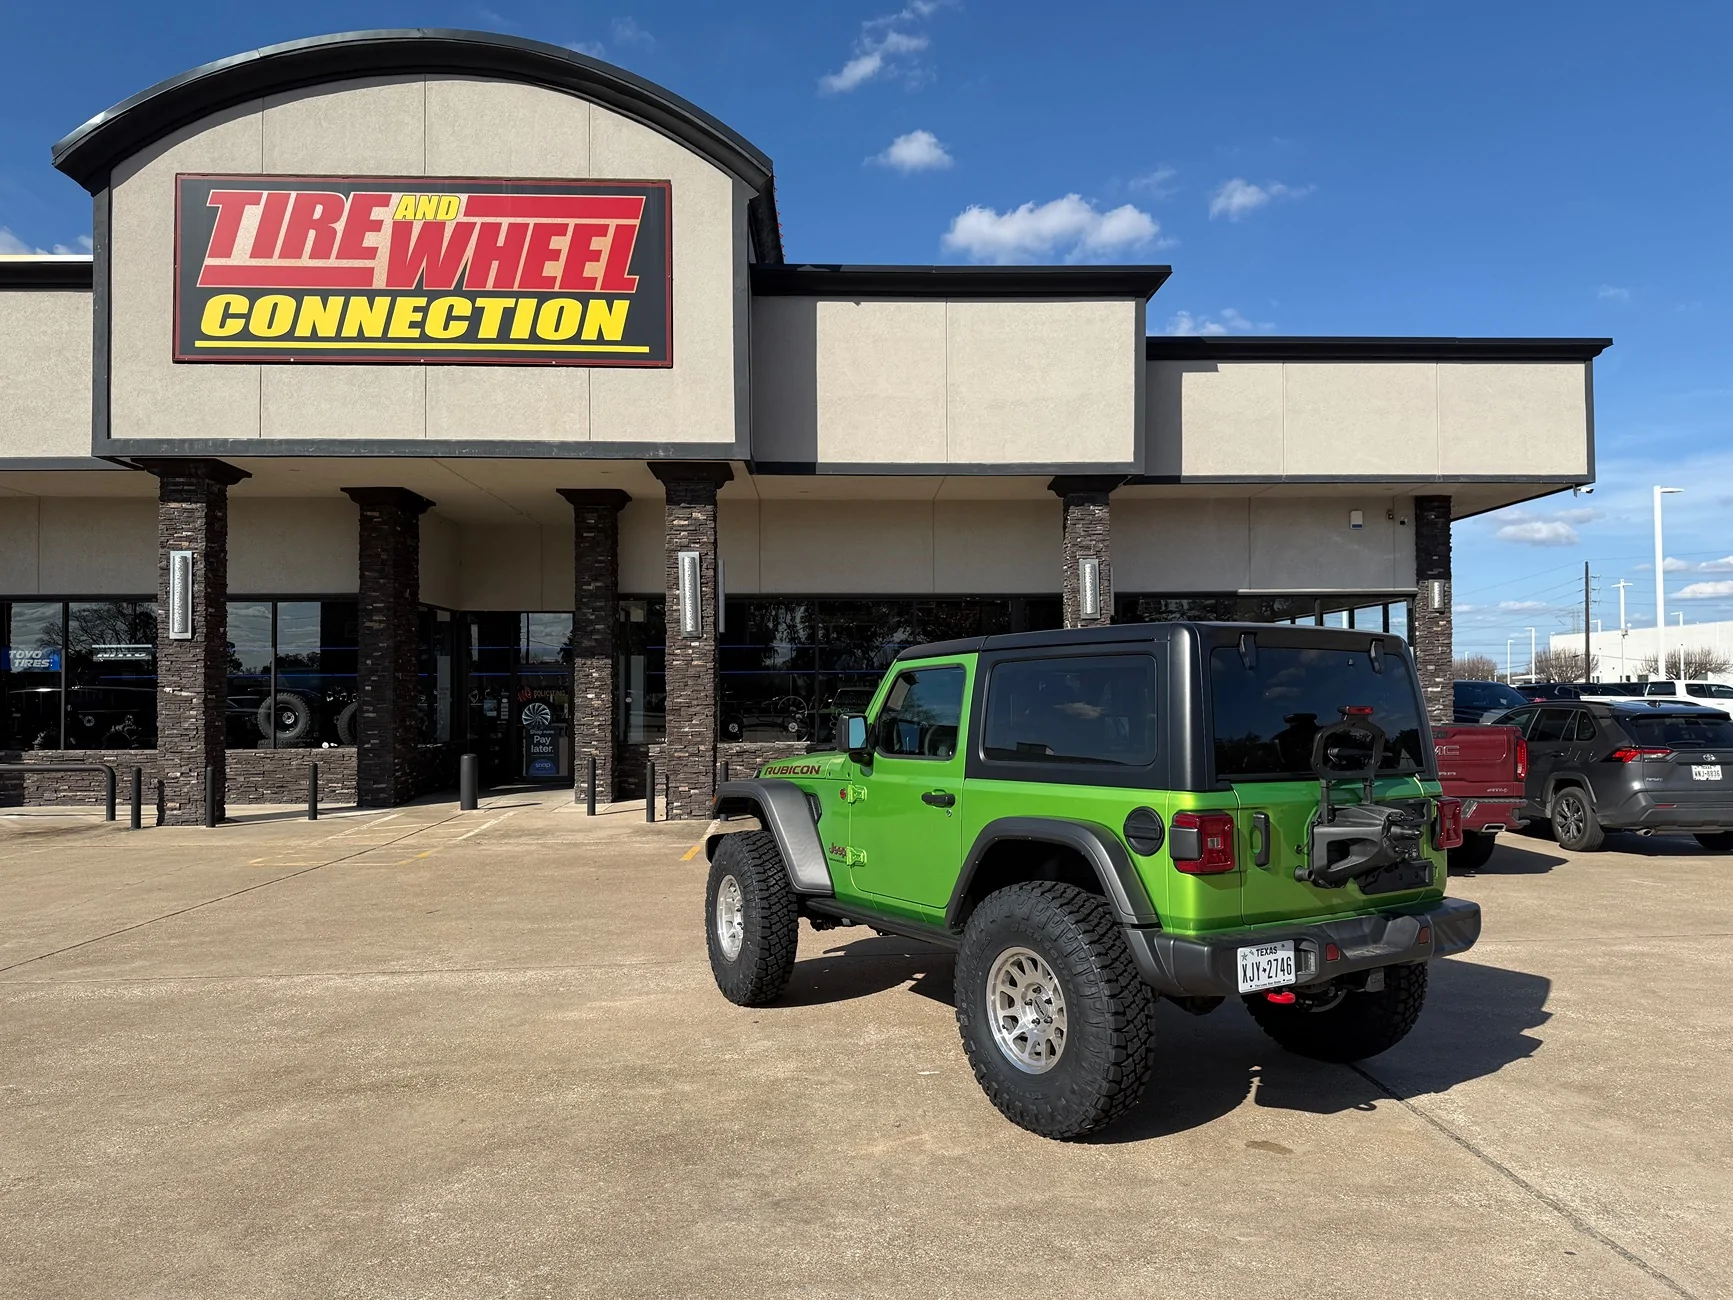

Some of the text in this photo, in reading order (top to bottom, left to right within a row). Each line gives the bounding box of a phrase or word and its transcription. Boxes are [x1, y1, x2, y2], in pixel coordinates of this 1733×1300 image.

[392, 194, 461, 221] AND
[206, 190, 393, 261] TIRE
[384, 218, 641, 293] WHEEL
[200, 293, 630, 342] CONNECTION
[9, 650, 42, 658] TOYO
[14, 659, 49, 668] TIRES
[533, 735, 551, 745] Pay
[531, 745, 554, 753] later.
[535, 762, 551, 770] snap
[764, 765, 821, 775] RUBICON
[1255, 946, 1278, 957] TEXAS
